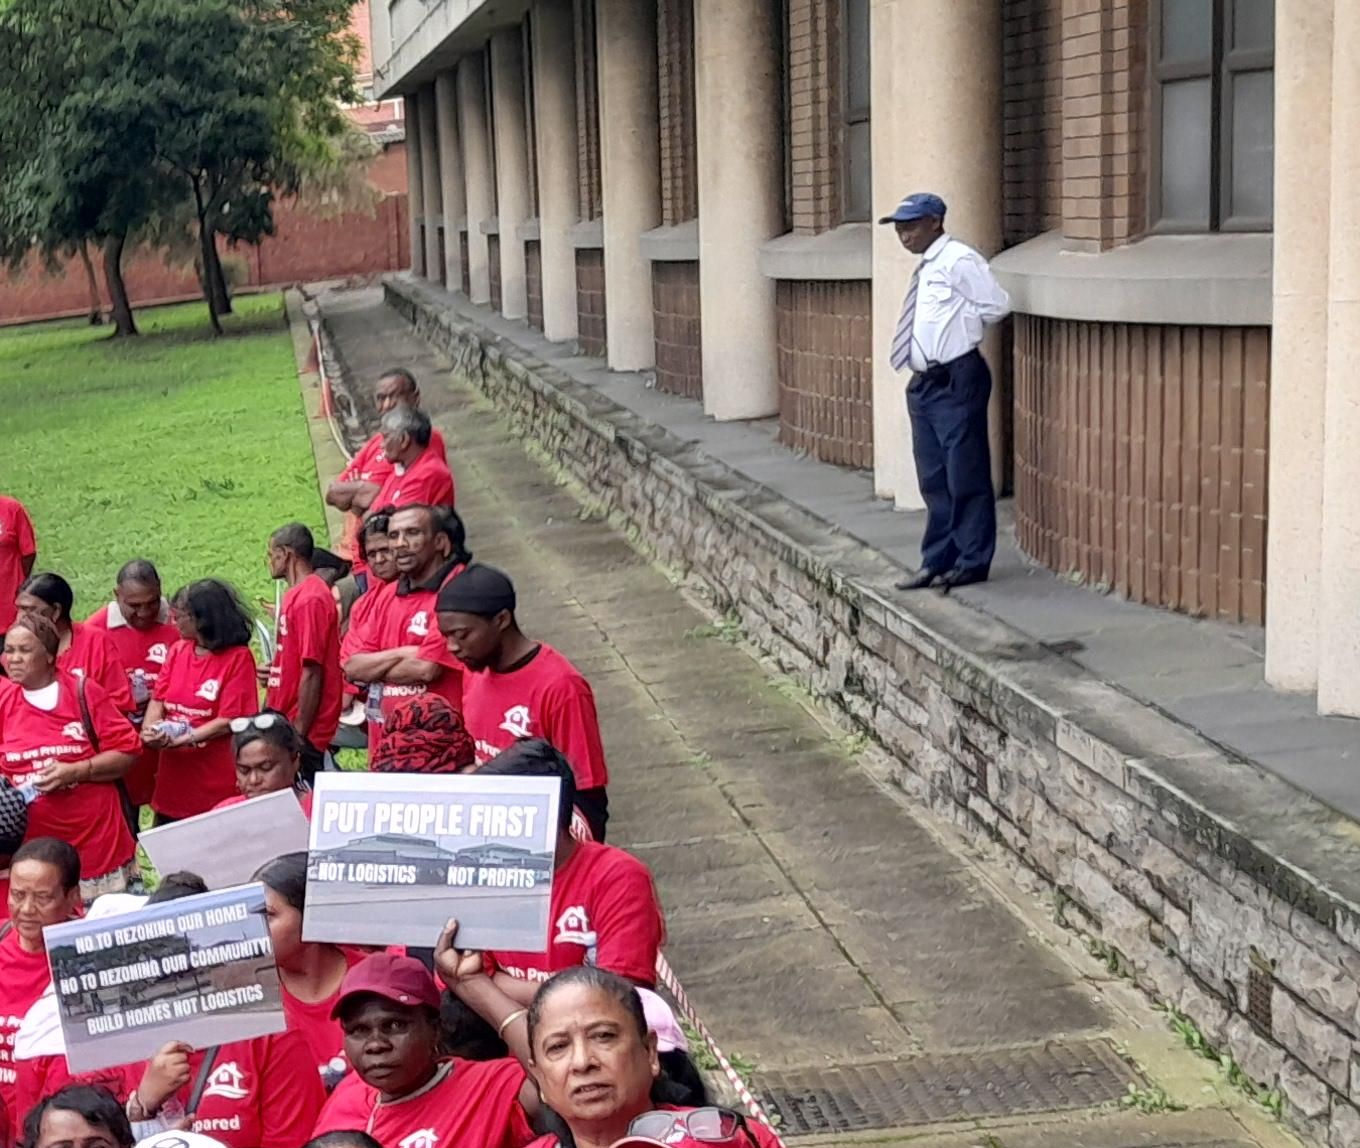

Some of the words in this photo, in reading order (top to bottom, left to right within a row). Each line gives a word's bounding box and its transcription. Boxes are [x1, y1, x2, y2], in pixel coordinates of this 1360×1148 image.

[323, 801, 369, 833] PUT
[374, 803, 464, 836] PEOPLE
[470, 805, 538, 838] FIRST
[318, 862, 346, 882] NOT
[347, 864, 417, 885] LOGISTICS
[447, 865, 476, 887] NOT
[478, 867, 535, 889] PROFITS
[75, 933, 94, 954] NO
[95, 930, 114, 950] TO
[114, 922, 176, 948] REZONING
[177, 913, 205, 934] OUR
[206, 903, 249, 927] HOME!
[60, 975, 78, 996] NO
[79, 972, 98, 992] TO
[98, 962, 160, 989] REZONING
[162, 954, 189, 974] OUR
[189, 937, 272, 969] COMMUNITY!
[87, 1012, 125, 1035] BUILD
[125, 1004, 173, 1028] HOMES
[174, 997, 199, 1018] NOT
[200, 984, 264, 1012] LOGISTICS
